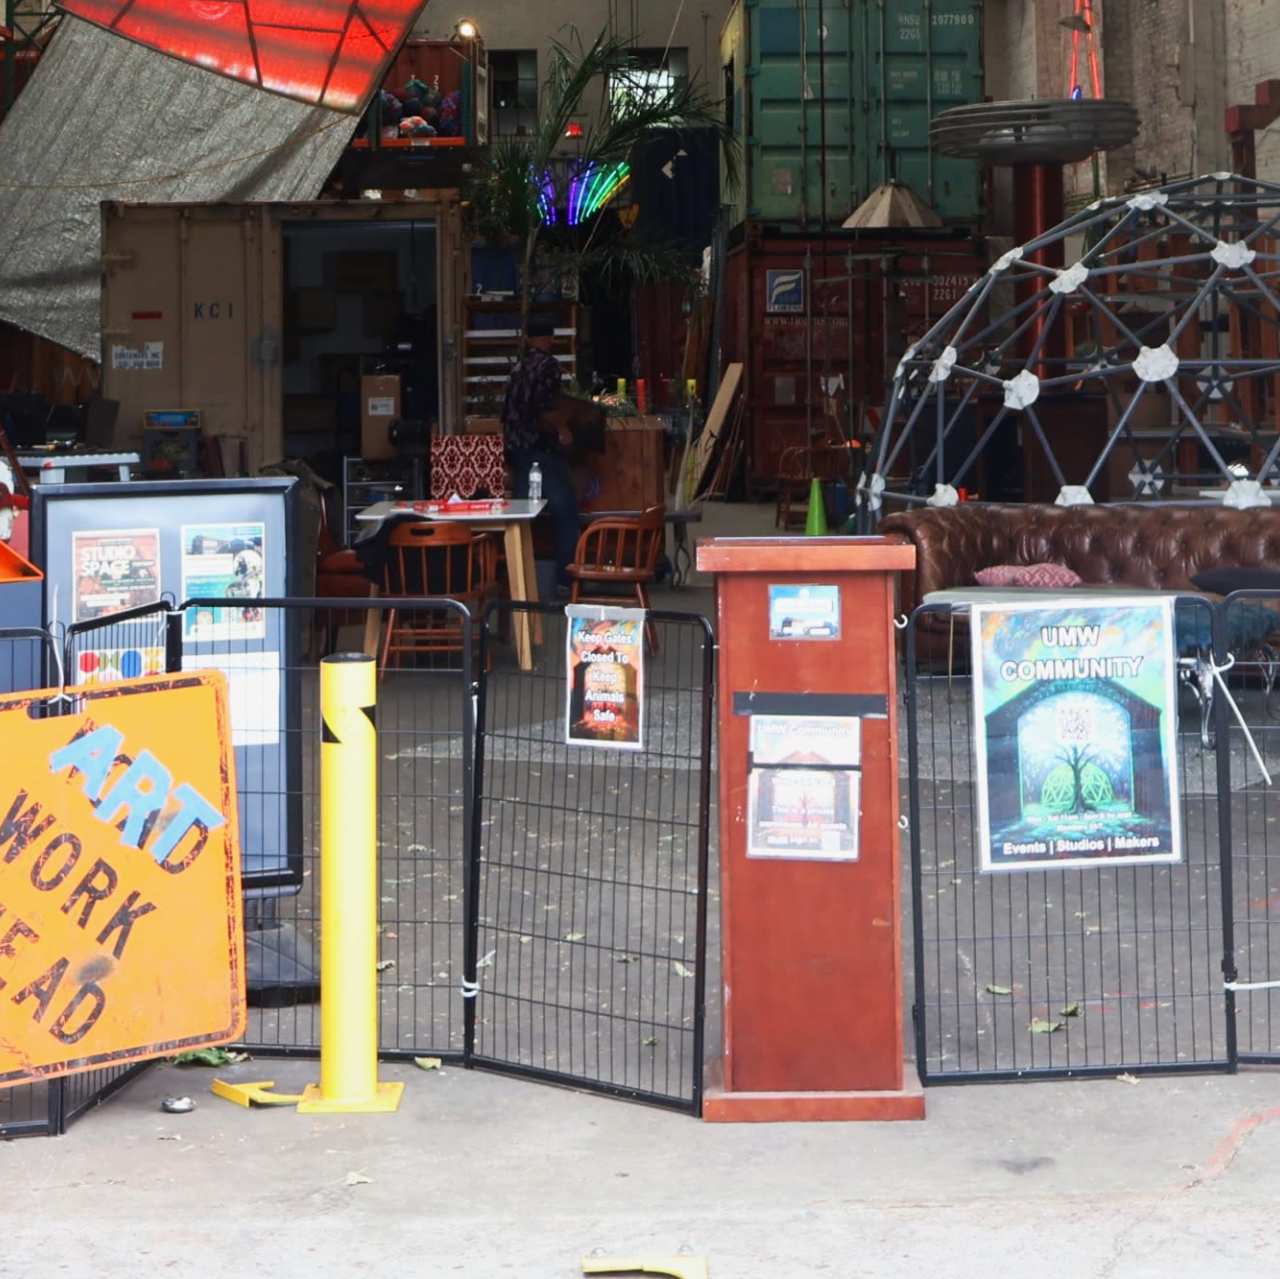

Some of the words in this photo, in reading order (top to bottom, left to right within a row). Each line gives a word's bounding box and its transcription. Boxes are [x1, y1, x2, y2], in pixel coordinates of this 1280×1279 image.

[80, 545, 136, 561] STUDIO
[80, 561, 131, 576] SPACE
[578, 630, 602, 644] Keep
[604, 632, 633, 643] Gates
[1040, 623, 1101, 648] UMW
[581, 651, 615, 663] Closed
[616, 652, 629, 663] To
[1000, 655, 1144, 683] COMMUNITY
[584, 690, 625, 703] Animals
[593, 708, 616, 721] Safe
[49, 723, 227, 865] ART
[1002, 841, 1047, 855] Events
[1055, 838, 1105, 853] Studios
[1114, 835, 1160, 850] Makers
